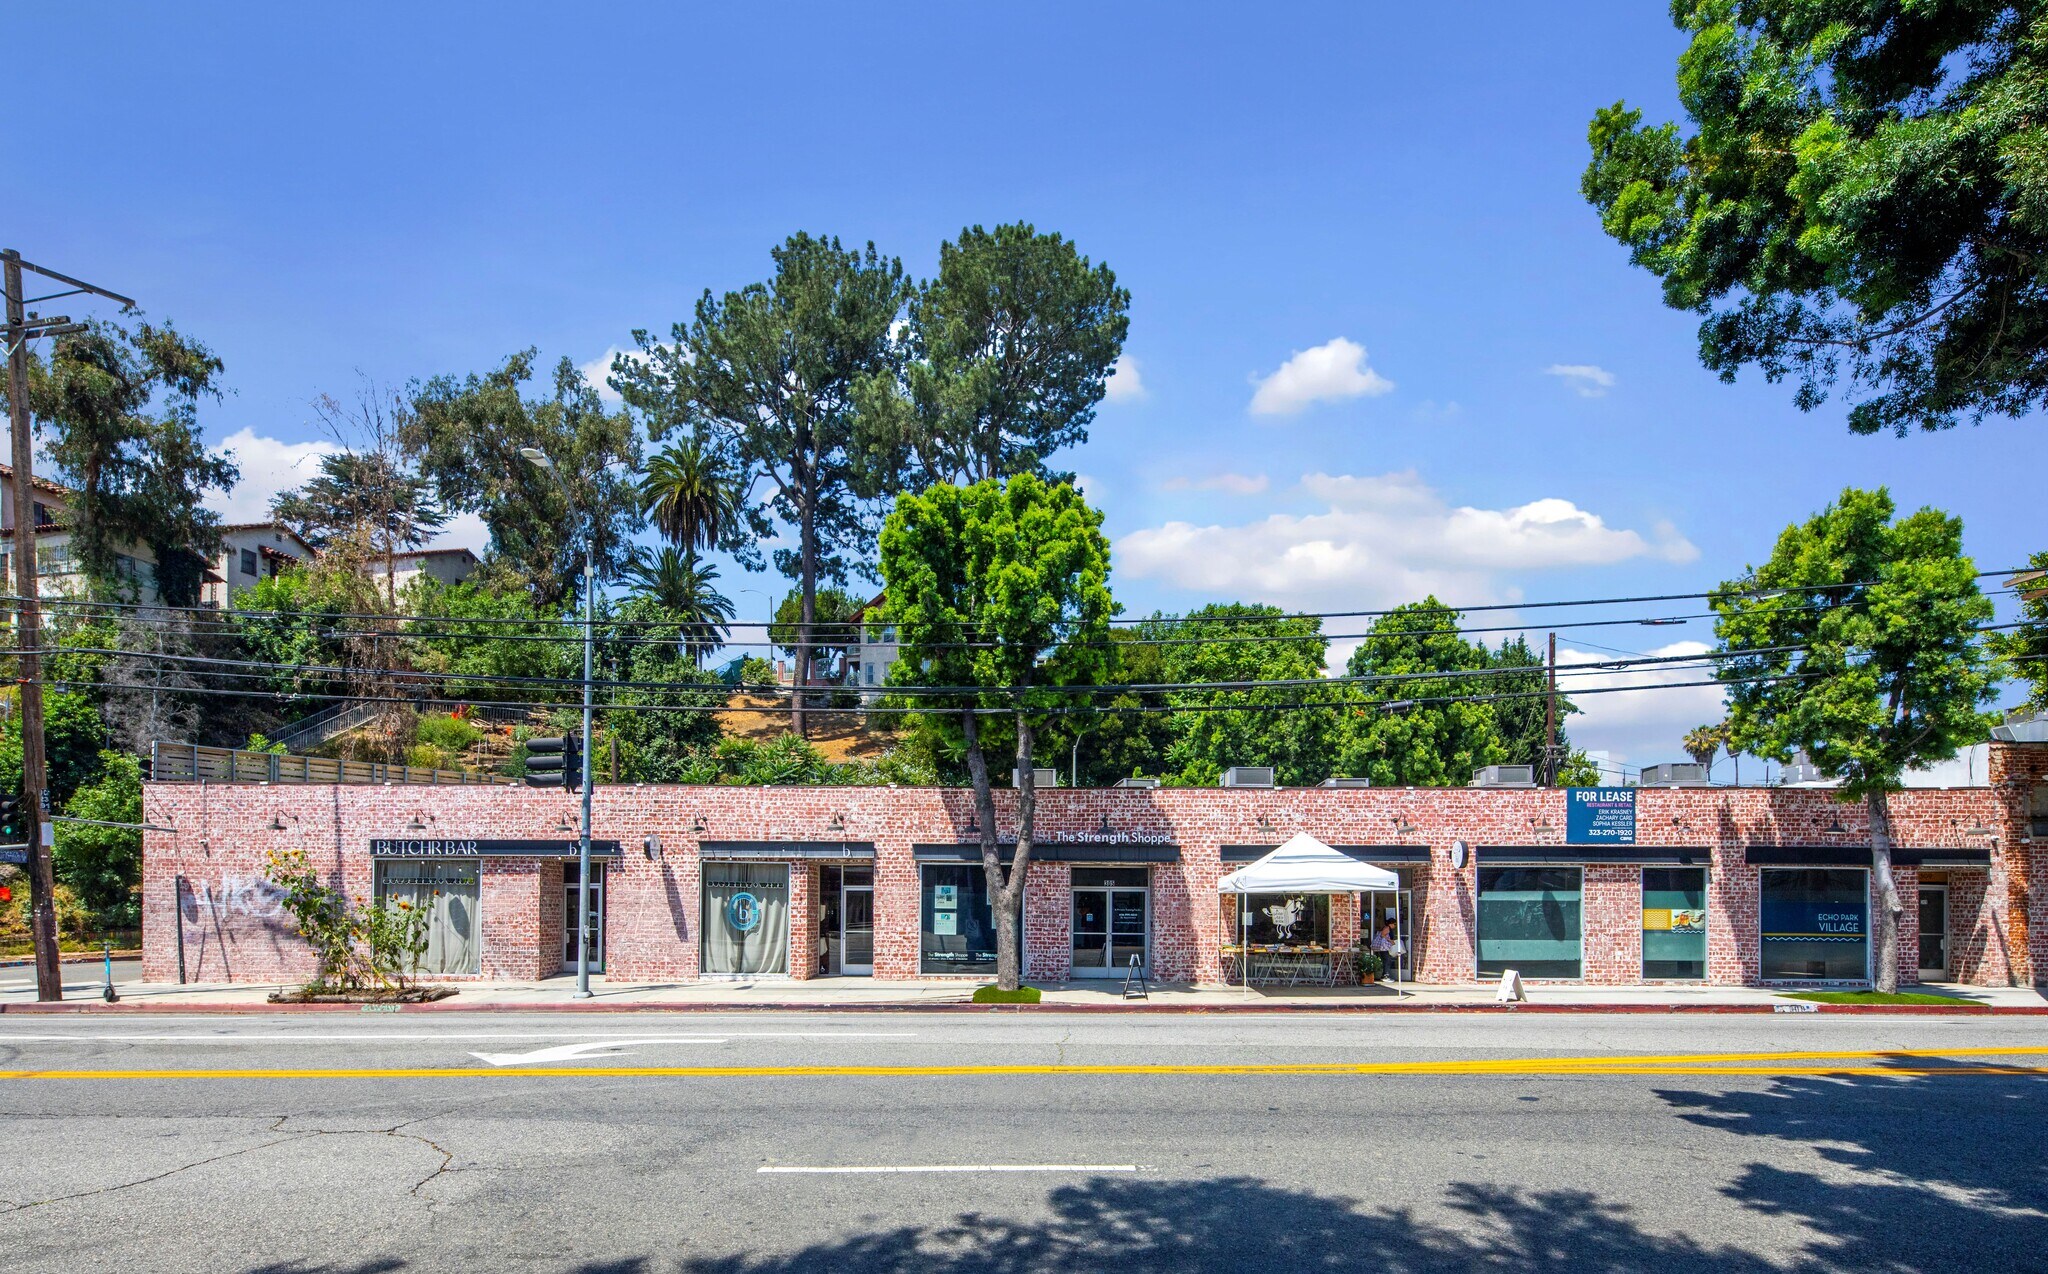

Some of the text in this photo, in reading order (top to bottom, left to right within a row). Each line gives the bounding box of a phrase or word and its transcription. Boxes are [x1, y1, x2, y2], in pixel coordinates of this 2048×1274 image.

[1576, 791, 1633, 802] FOR LEASE
[1056, 831, 1075, 842] The
[1077, 831, 1129, 845] Strength
[1131, 831, 1171, 845] Shoppe
[376, 840, 478, 855] BUTCHR BAR
[569, 841, 578, 856] b
[842, 843, 851, 857] b
[1818, 913, 1859, 921] ECHO PARK
[1818, 922, 1859, 932] VILLAGE
